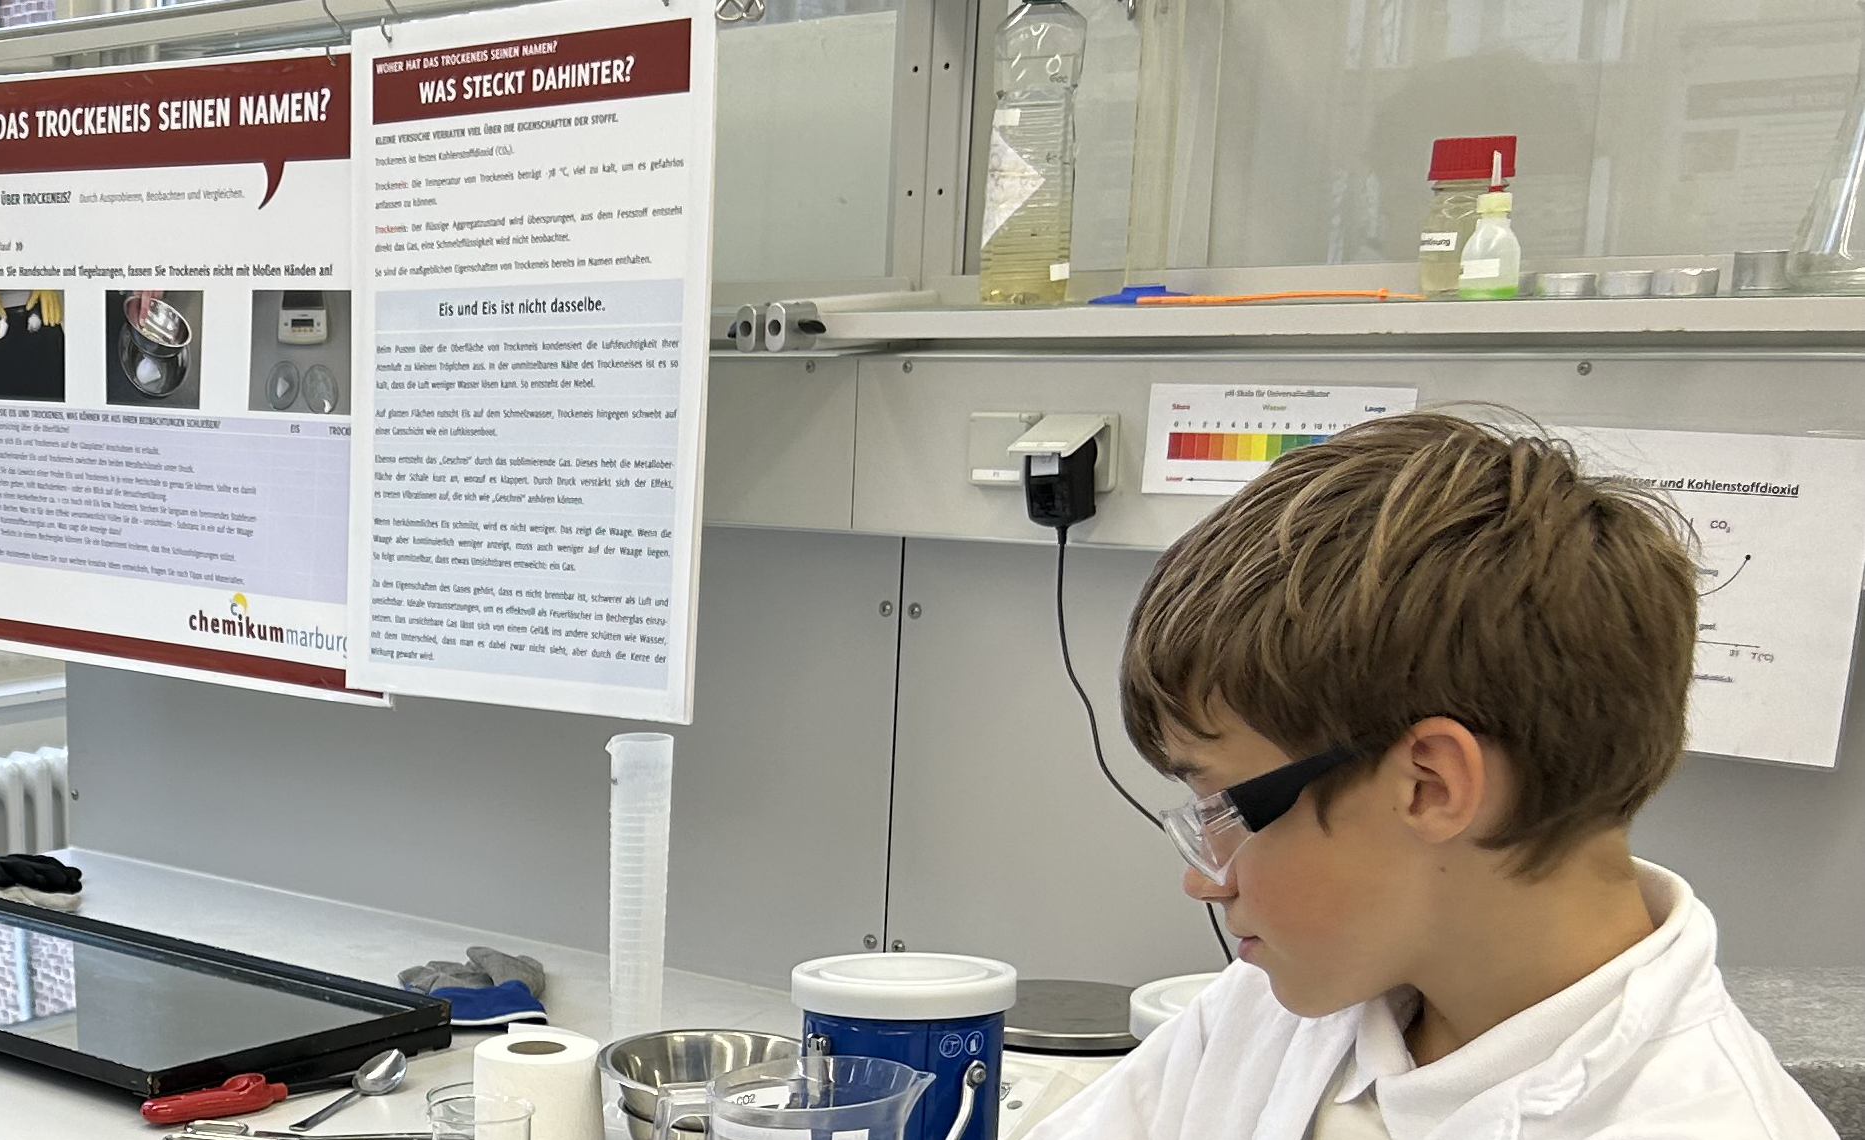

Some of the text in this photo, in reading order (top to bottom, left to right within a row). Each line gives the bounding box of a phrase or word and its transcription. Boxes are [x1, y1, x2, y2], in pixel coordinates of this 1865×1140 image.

[375, 40, 557, 74] WOHER HAT DAS TROCKENEIS SEINEN NAMEN?
[419, 57, 634, 103] WAS STECKT DAHINTER?
[35, 103, 150, 136] TROCKENEIS
[158, 98, 230, 130] SEINEN
[239, 88, 330, 125] NAMEN?
[0, 190, 20, 205] ÜBER
[22, 191, 71, 204] TROCKENEIS?
[6, 265, 17, 277] Sie
[62, 265, 76, 276] und
[127, 265, 152, 276] fassen
[154, 264, 166, 276] Sie
[168, 264, 210, 276] Trockeneis
[212, 264, 233, 276] nicht
[235, 264, 250, 276] mit
[252, 263, 281, 276] bloßen
[283, 263, 316, 276] Händen
[318, 263, 333, 276] an!
[438, 296, 605, 316] Eis und Eis ist nicht dasselbe.
[290, 424, 301, 433] EIS
[1660, 478, 1684, 489] und
[1687, 479, 1799, 496] Kohlenstoffdioxid
